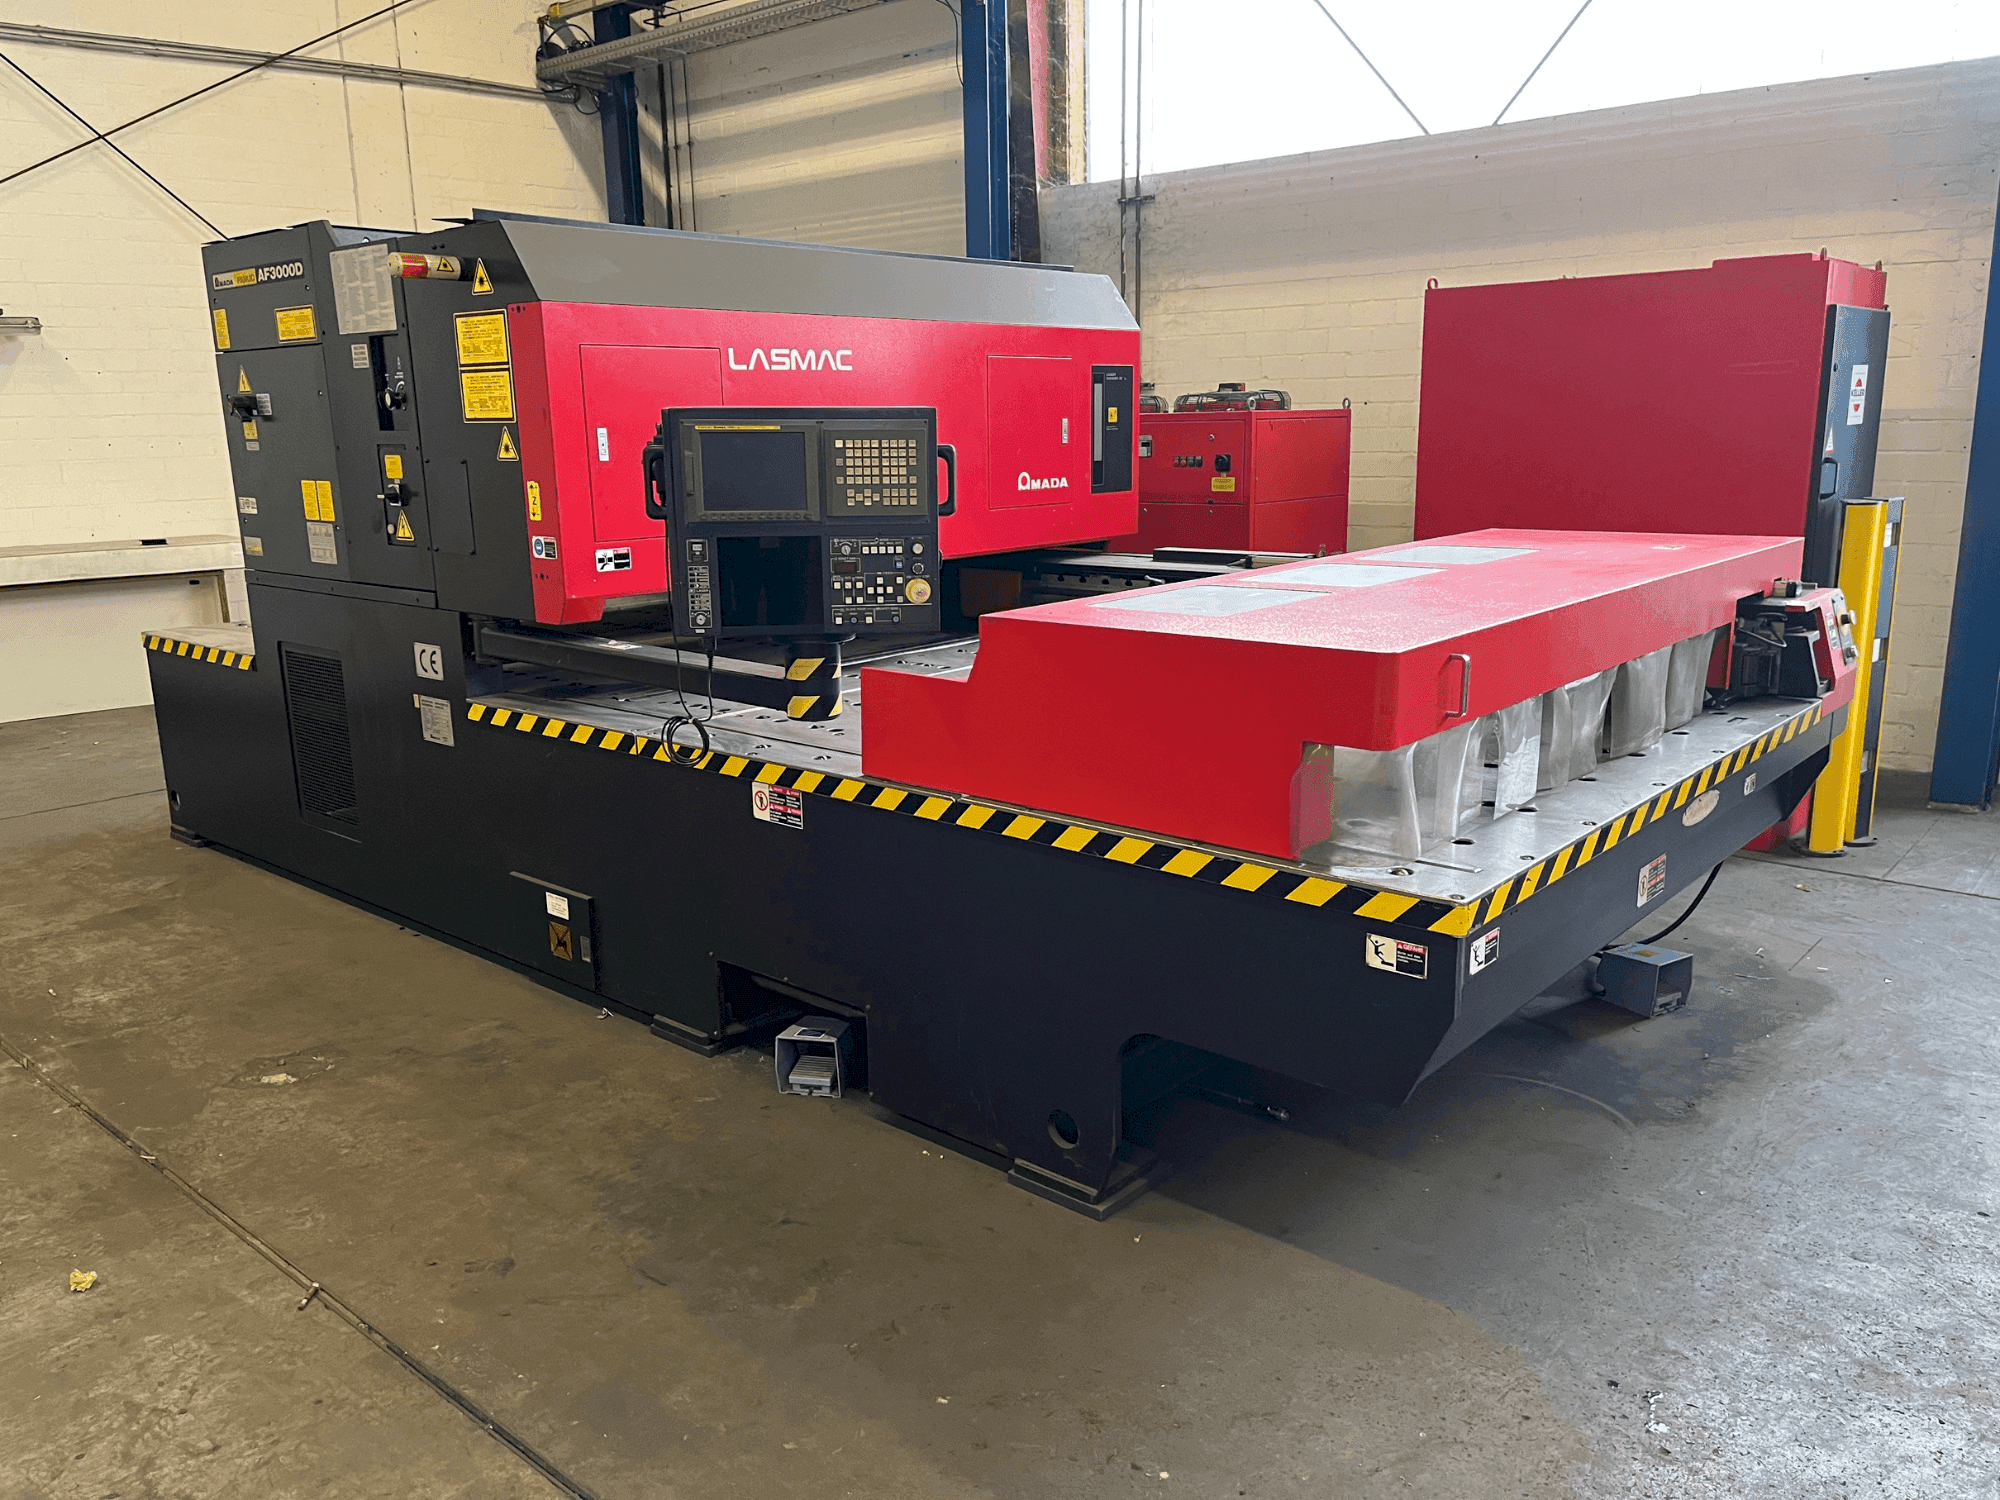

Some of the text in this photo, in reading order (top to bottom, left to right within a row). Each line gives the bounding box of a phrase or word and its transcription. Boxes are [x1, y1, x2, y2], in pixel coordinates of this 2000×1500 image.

[258, 261, 303, 282] AF3000D
[728, 347, 853, 371] LASMAC
[1017, 471, 1069, 491] AMADA
[419, 648, 439, 675] CE
